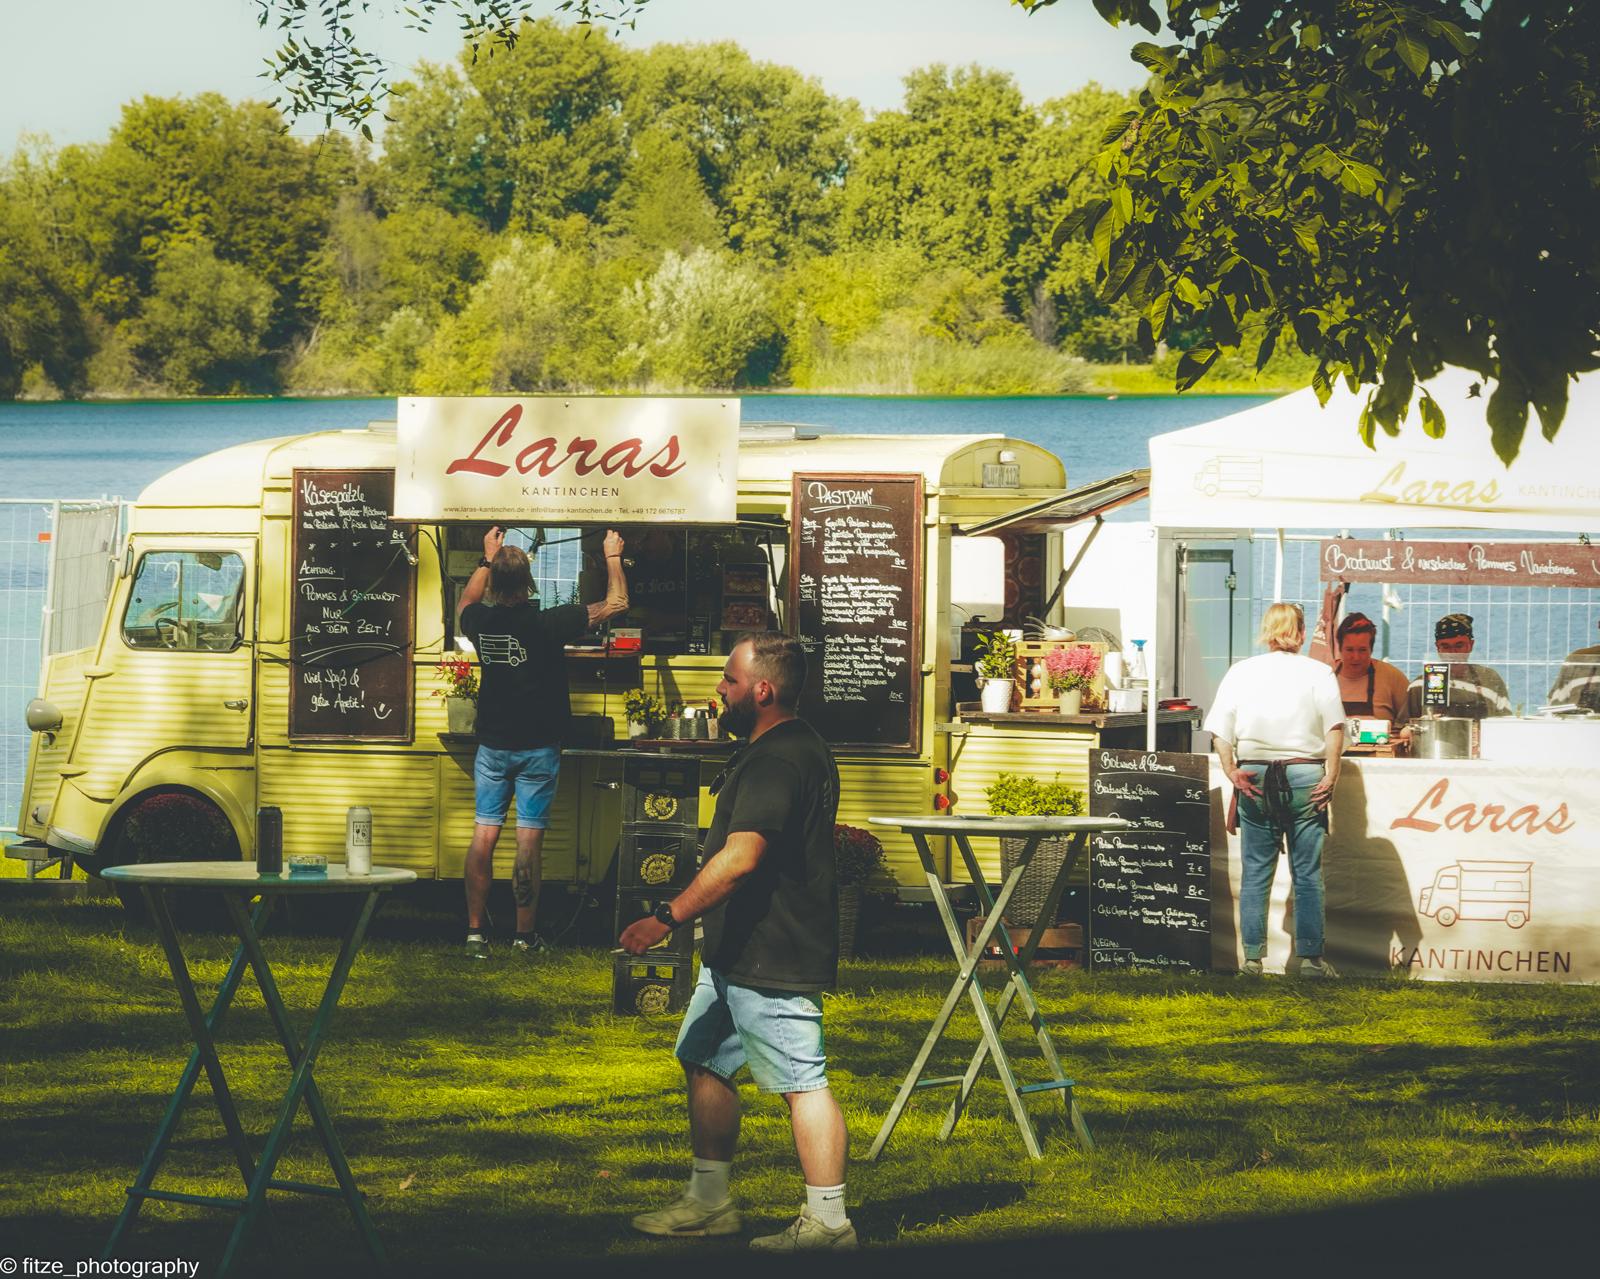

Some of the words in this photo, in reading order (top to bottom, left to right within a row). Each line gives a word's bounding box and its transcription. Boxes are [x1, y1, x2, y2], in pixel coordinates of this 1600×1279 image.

[446, 403, 687, 479] Laras
[522, 486, 620, 497] KANTINCHEN
[1360, 461, 1504, 504] Laras
[1518, 484, 1600, 499] KANTINCH
[1325, 544, 1395, 573] Bratwurst
[1402, 546, 1414, 572] &
[1469, 544, 1517, 572] Pommes
[301, 583, 337, 601] POMMES
[323, 606, 343, 620] NUR
[326, 624, 348, 634] DEM
[1389, 777, 1576, 835] Laras
[1391, 946, 1571, 973] KANTINCHEN
